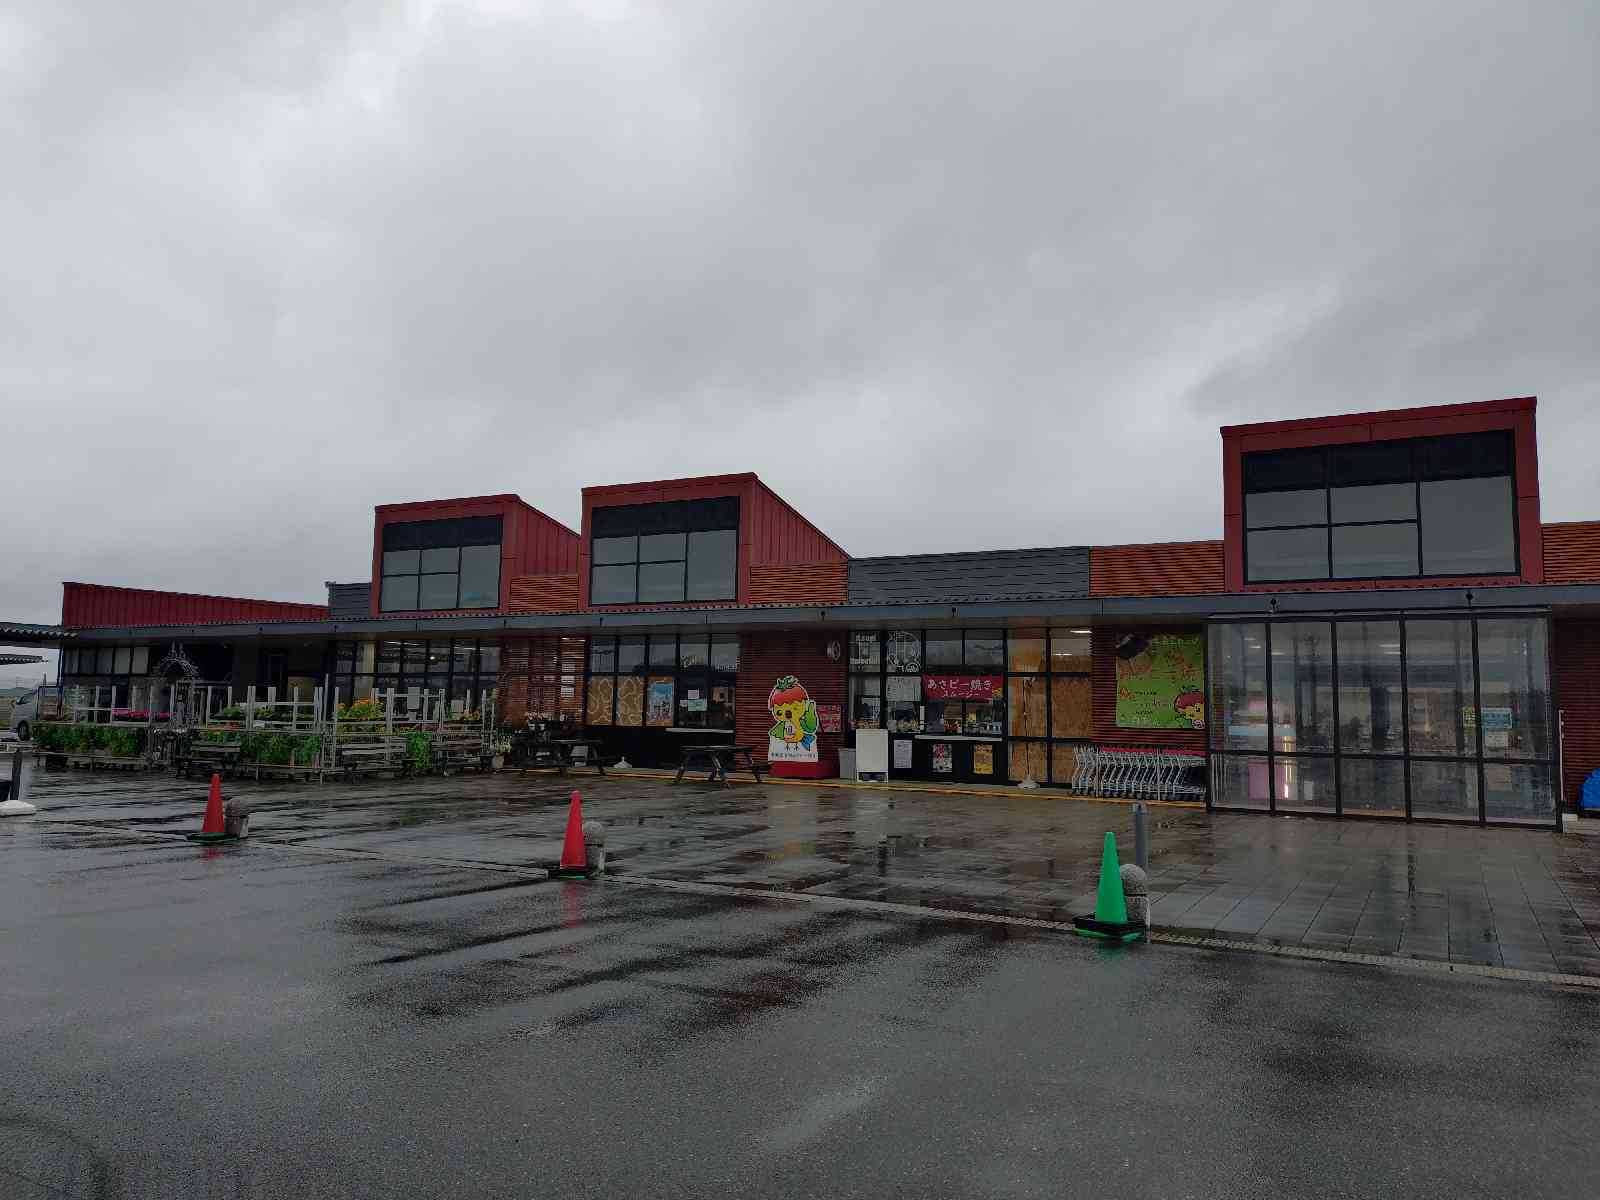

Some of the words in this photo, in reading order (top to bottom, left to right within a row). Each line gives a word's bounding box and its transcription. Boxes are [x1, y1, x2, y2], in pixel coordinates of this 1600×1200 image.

[927, 679, 993, 691] あさピー焼き
